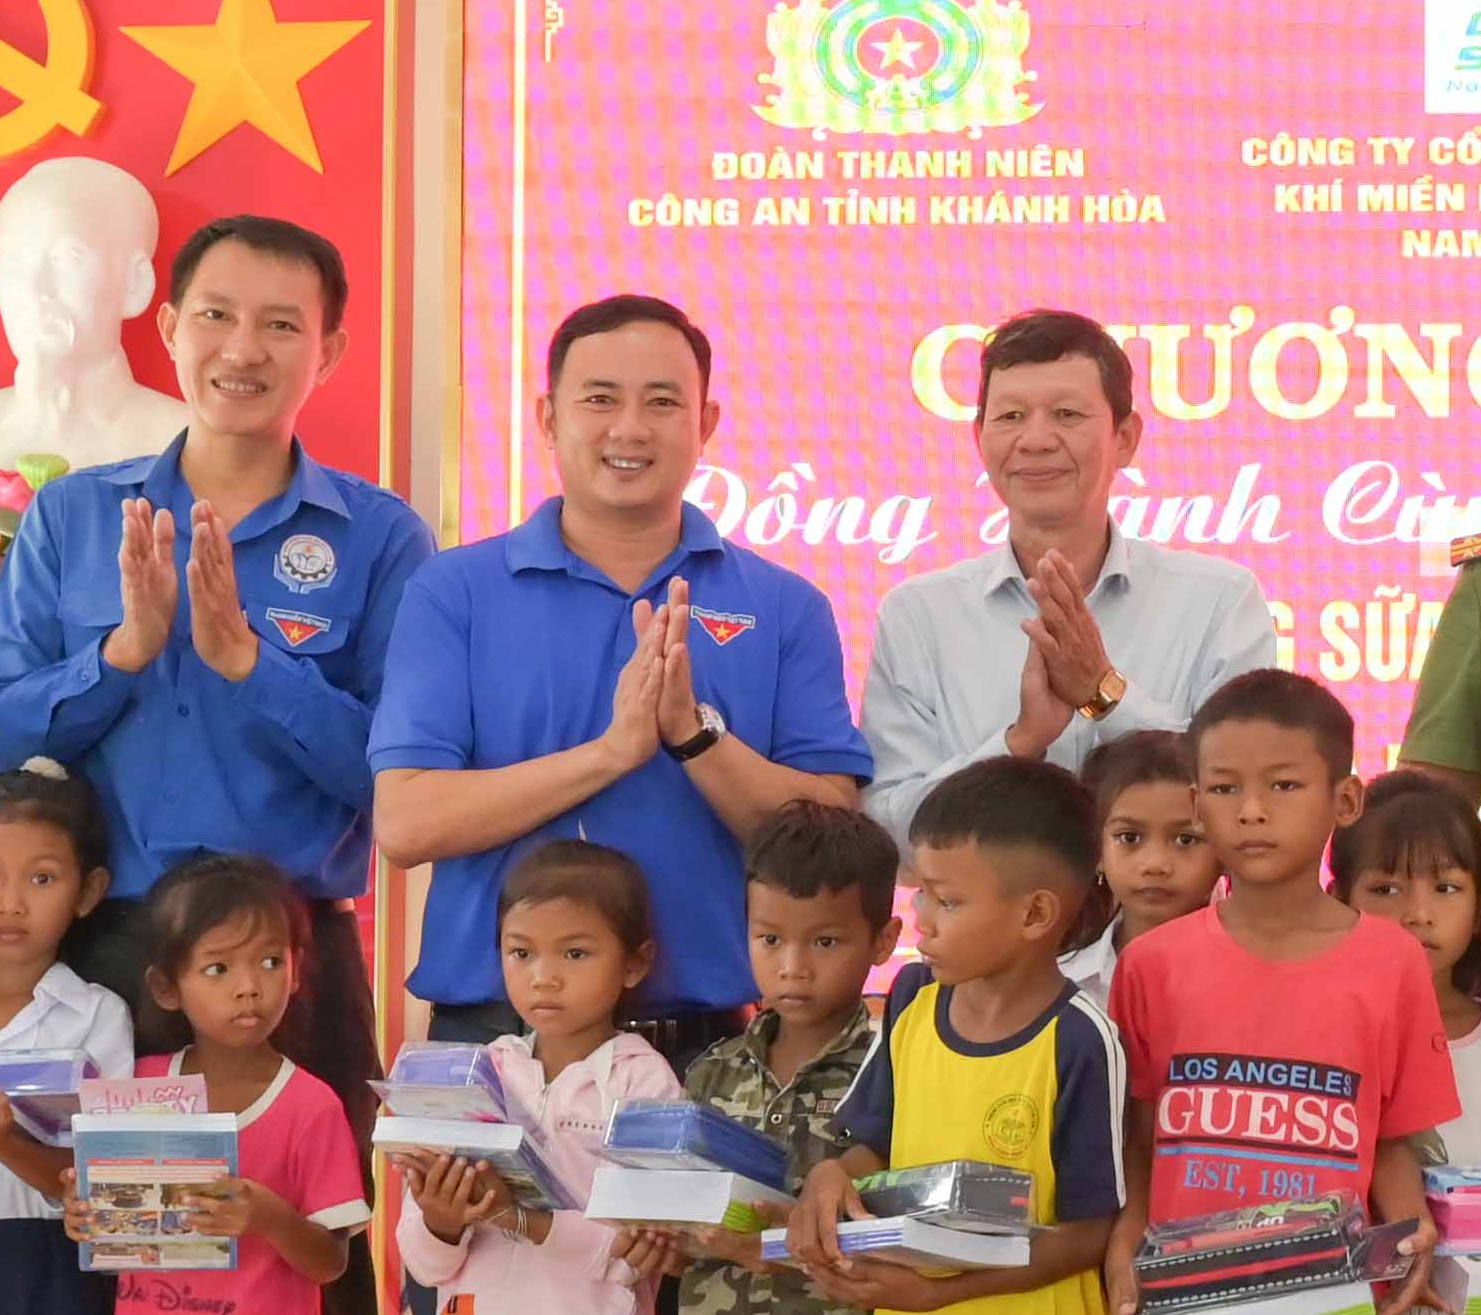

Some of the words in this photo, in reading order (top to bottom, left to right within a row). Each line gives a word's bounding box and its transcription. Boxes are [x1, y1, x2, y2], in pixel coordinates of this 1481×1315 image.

[712, 145, 824, 181] ĐOÀN
[837, 149, 972, 179] THANH
[985, 143, 1085, 177] NIÊN
[1241, 131, 1356, 166] CÔNG
[1368, 138, 1415, 165] TY
[628, 192, 740, 227] CÔNG
[753, 198, 811, 225] AN
[823, 189, 917, 225] TỈNH
[930, 189, 1070, 224] KHÁNH
[1083, 190, 1166, 223] HÒA
[1275, 178, 1343, 213] KHÍ
[1357, 173, 1466, 213] MIỀN
[1168, 1057, 1218, 1082] LOS
[1224, 1059, 1354, 1097] ANGELES
[1158, 1086, 1360, 1151] GUESS
[1259, 1168, 1317, 1200] 1981
